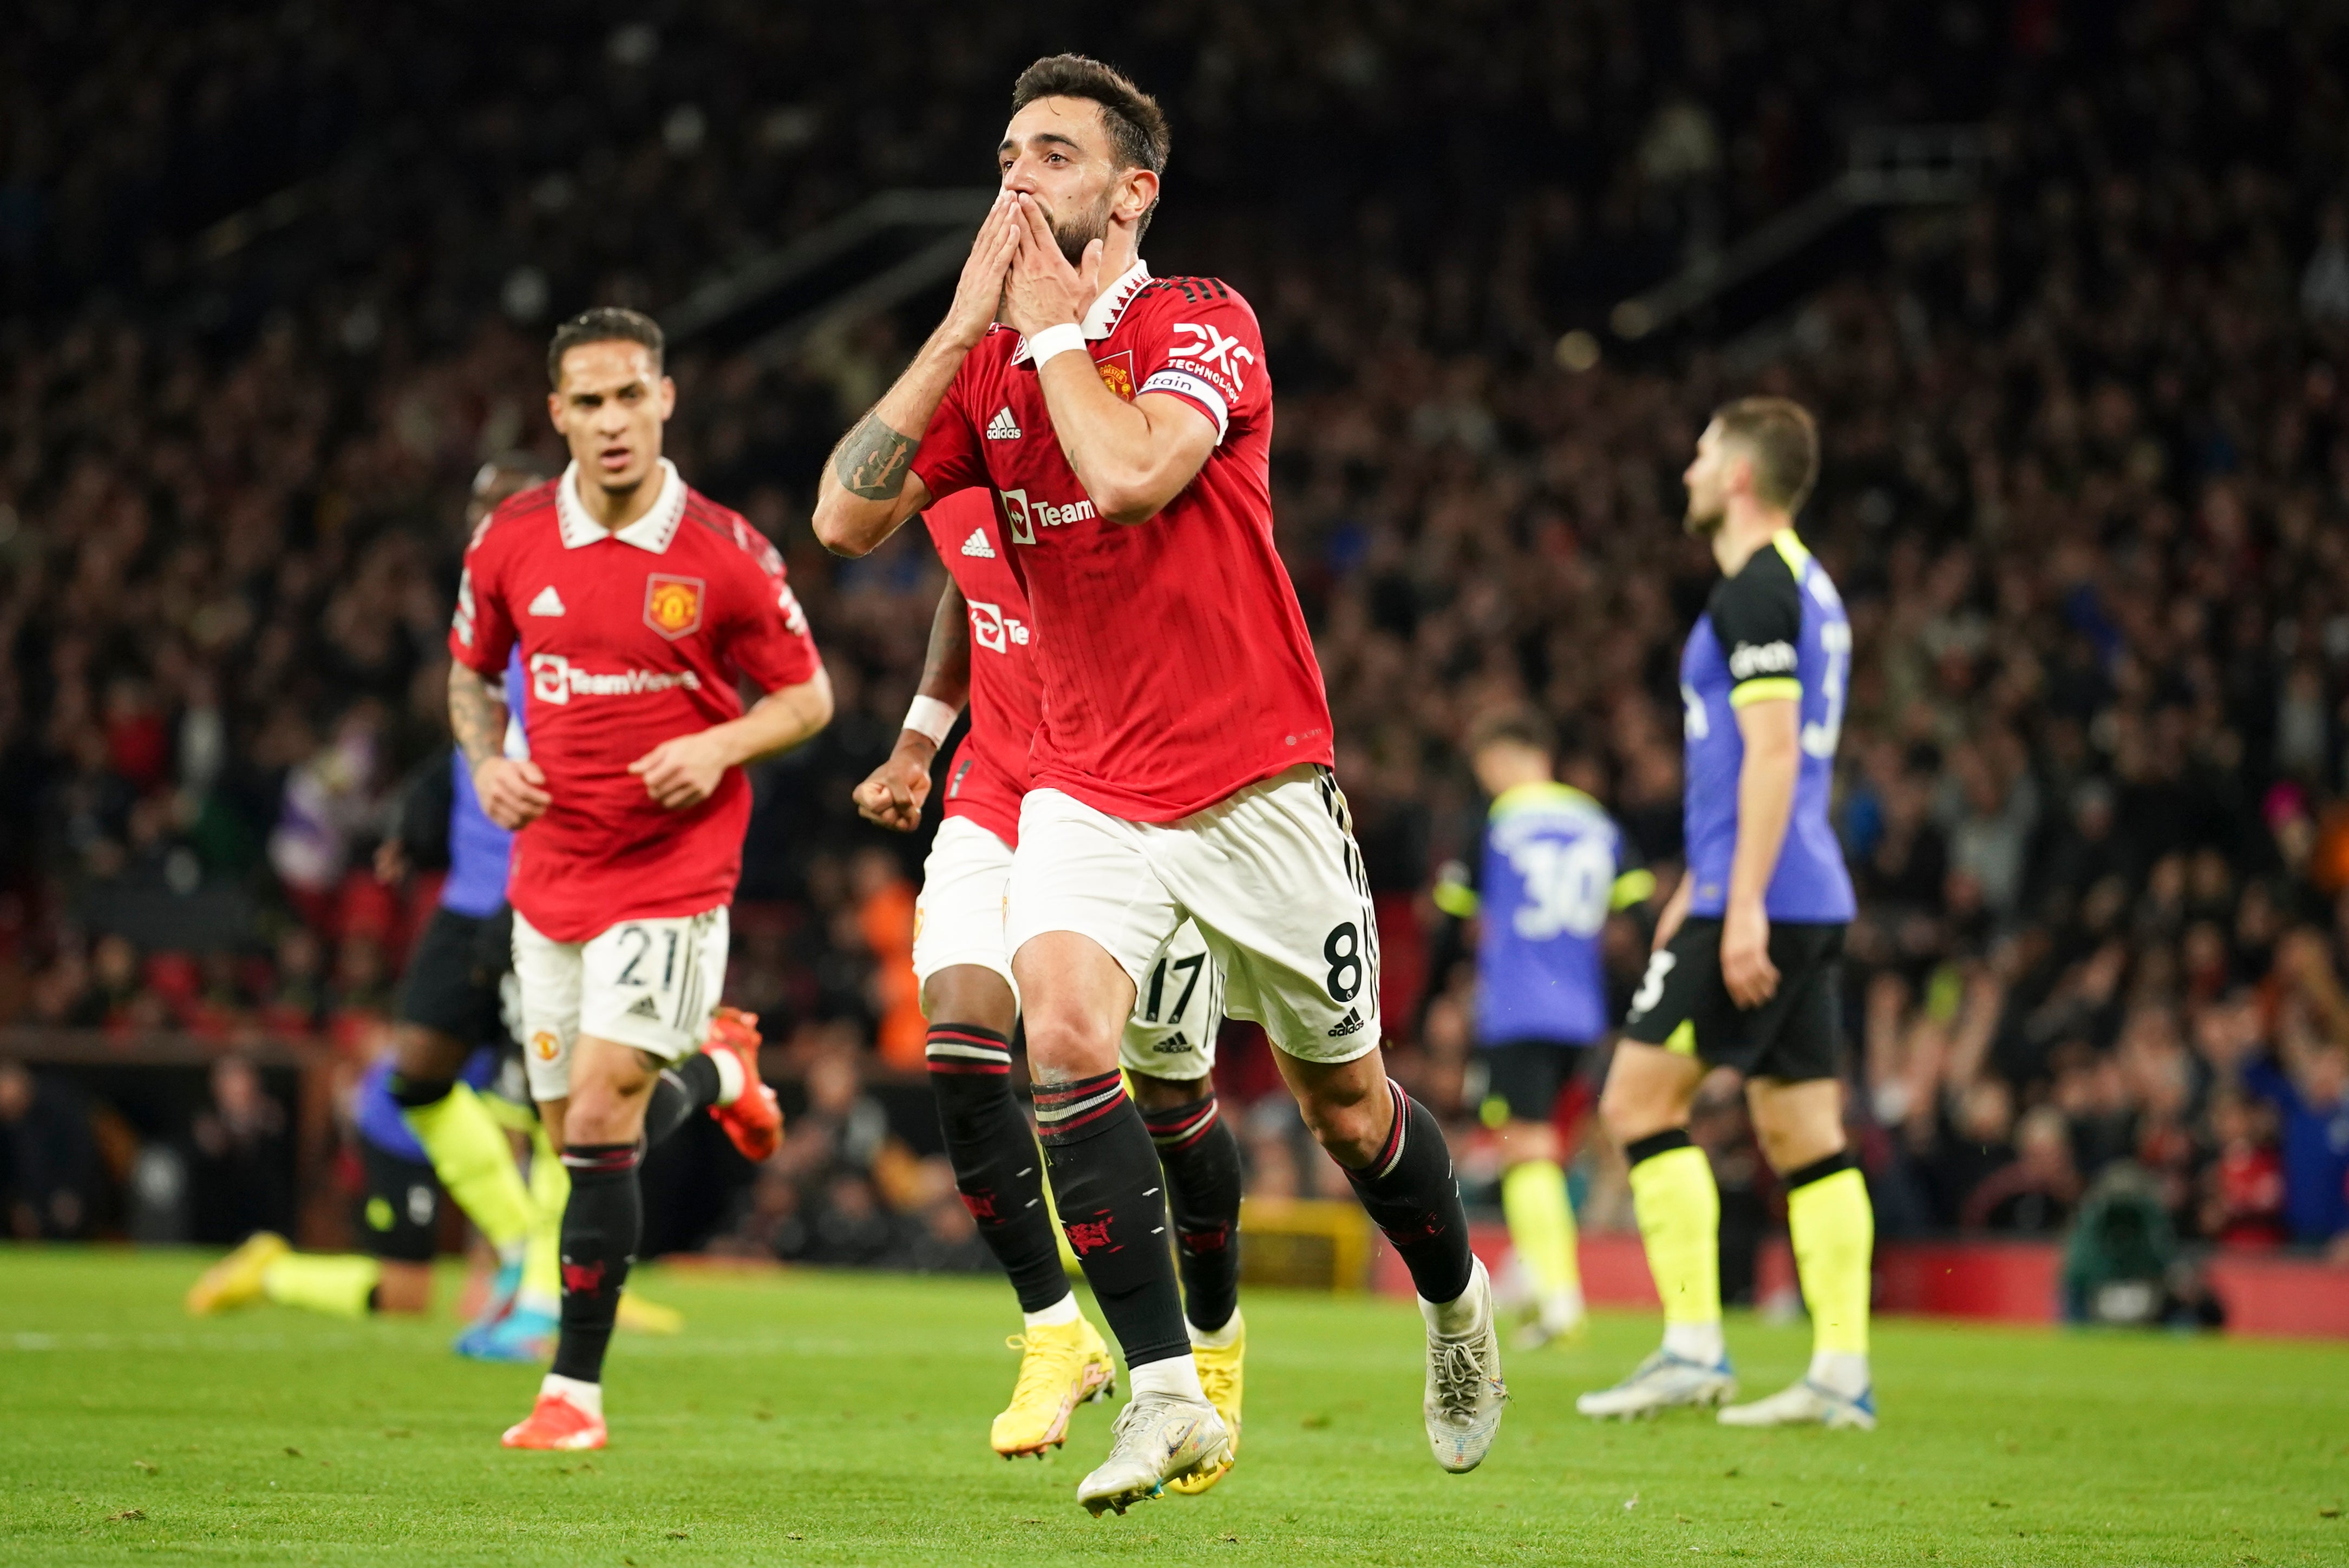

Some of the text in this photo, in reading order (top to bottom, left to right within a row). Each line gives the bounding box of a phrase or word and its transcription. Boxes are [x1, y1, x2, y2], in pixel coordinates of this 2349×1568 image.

[1144, 376, 1192, 390] tain
[1167, 359, 1239, 404] TECHNOLOGY
[1168, 323, 1254, 392] DXC
[986, 427, 1022, 439] adidas
[616, 924, 680, 992] 21
[1324, 921, 1363, 1002] 8
[1146, 950, 1207, 1025] 17
[1328, 1020, 1364, 1036] adidas
